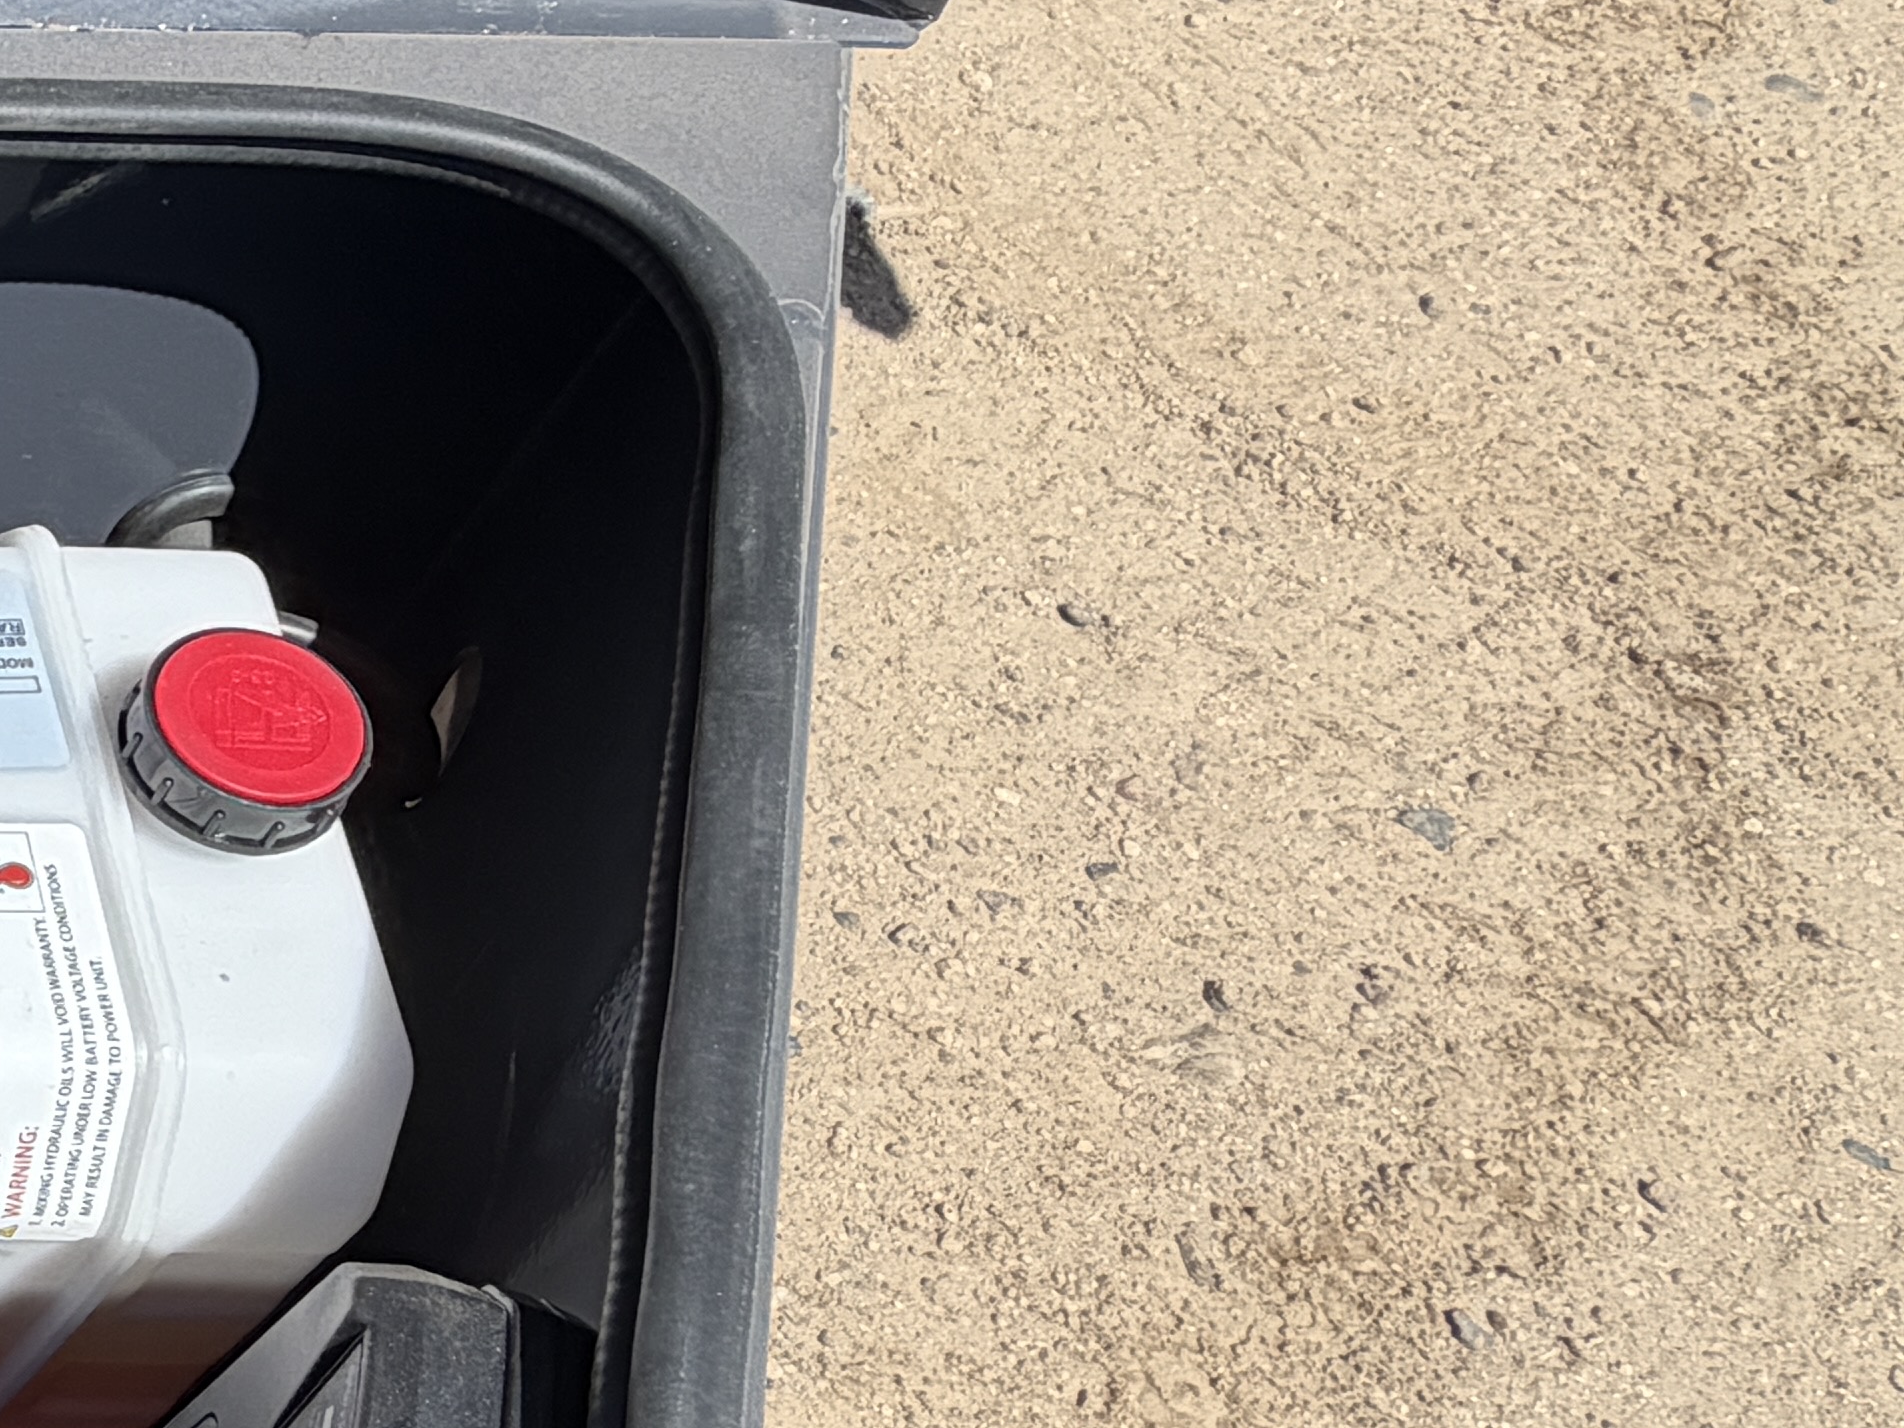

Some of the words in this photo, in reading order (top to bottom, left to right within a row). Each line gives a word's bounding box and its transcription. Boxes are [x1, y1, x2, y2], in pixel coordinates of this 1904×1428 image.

[44, 864, 72, 942] CONDITIONS
[63, 946, 86, 1002] VOLTAGE
[77, 1005, 98, 1065] BATTERY
[96, 994, 119, 1042] POWER
[60, 1028, 74, 1063] WILL
[108, 1047, 122, 1065] TO
[58, 1067, 75, 1096] OILS
[81, 1069, 98, 1099] LOW
[99, 1071, 122, 1125] DAMAGE
[43, 1100, 70, 1170] HYDRAULIC
[71, 1103, 92, 1145] UNDER
[96, 1129, 110, 1141] IN
[1, 1126, 39, 1218] WARNING:
[55, 1149, 83, 1217] OPERATING
[85, 1145, 106, 1188] RESULT
[79, 1192, 95, 1216] MAY
